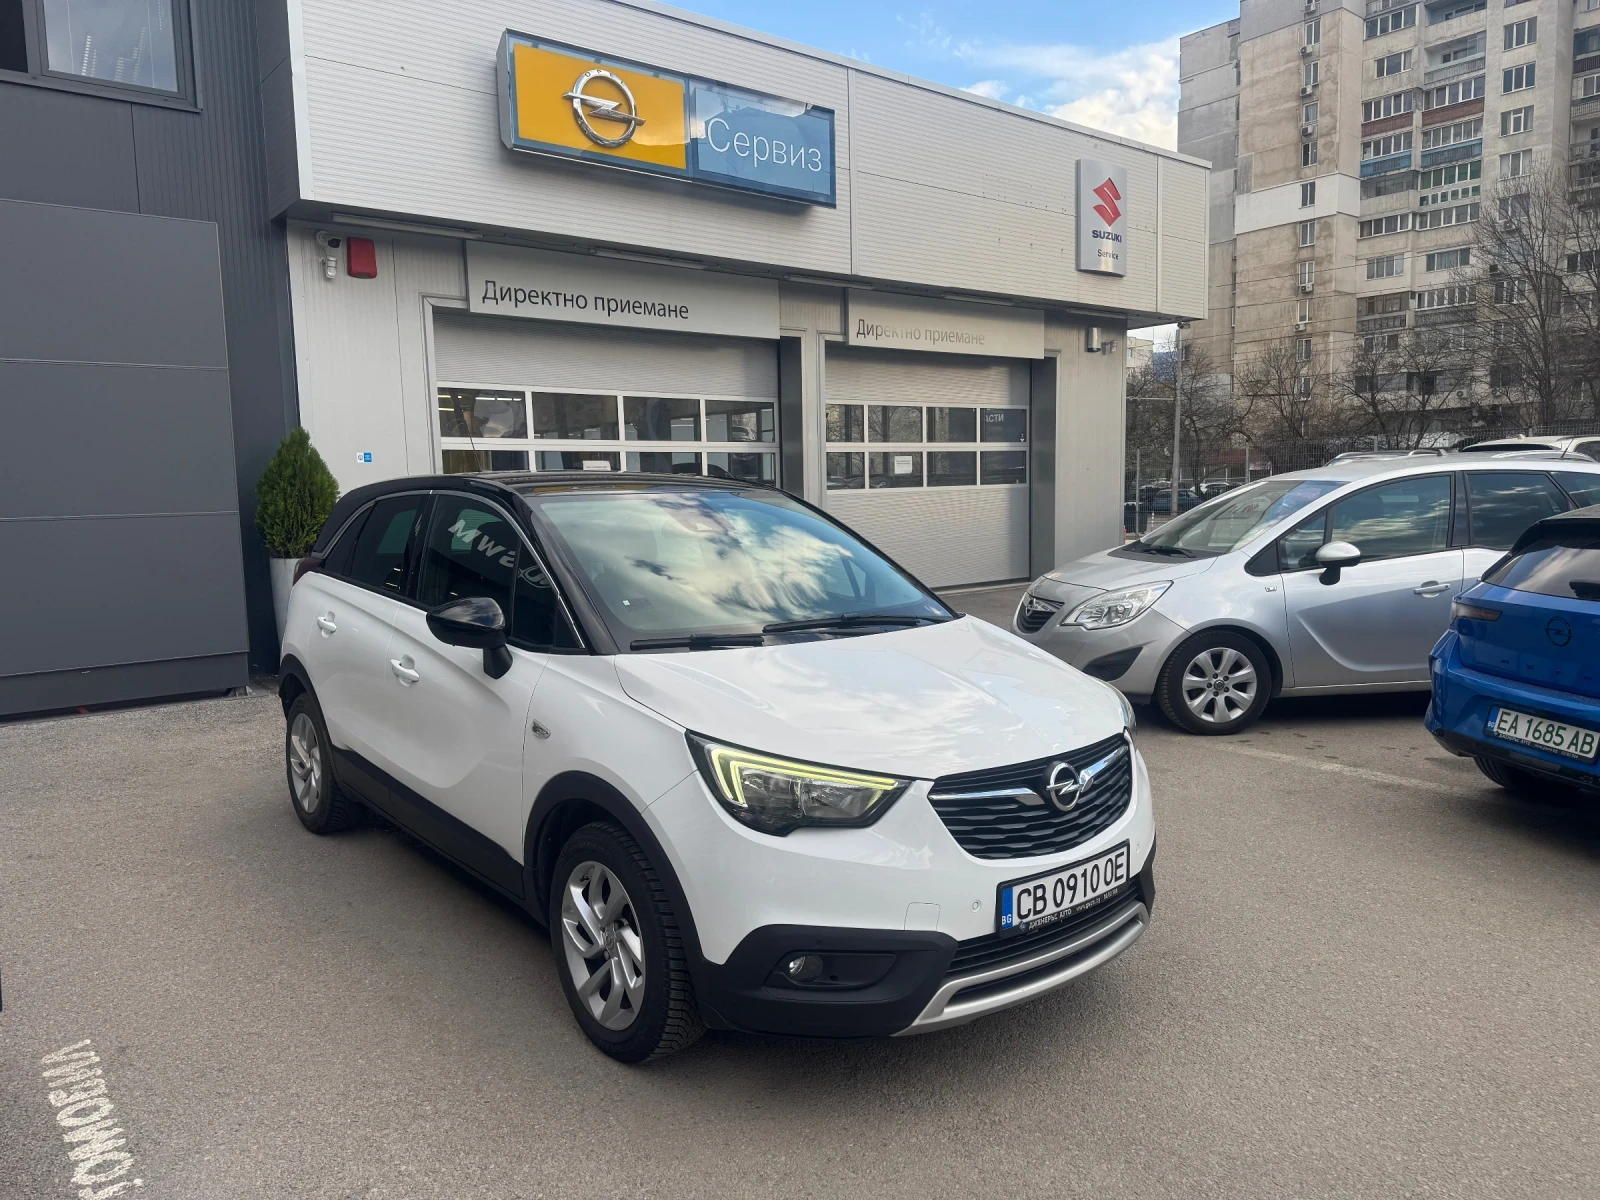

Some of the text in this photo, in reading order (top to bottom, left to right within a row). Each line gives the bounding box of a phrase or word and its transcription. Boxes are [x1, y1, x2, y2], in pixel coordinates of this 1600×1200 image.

[707, 118, 822, 172] Сервиз
[1091, 229, 1122, 243] SUZUKI
[1097, 248, 1119, 261] Service
[482, 280, 689, 320] Директно приемане
[856, 318, 986, 346] Директно приемане
[1497, 711, 1519, 735] EA
[1525, 718, 1567, 747] 1685
[1566, 730, 1595, 755] AB
[1016, 883, 1048, 920] CB
[1052, 863, 1100, 909] 0910
[1103, 850, 1125, 886] OE
[1001, 913, 1012, 926] BG
